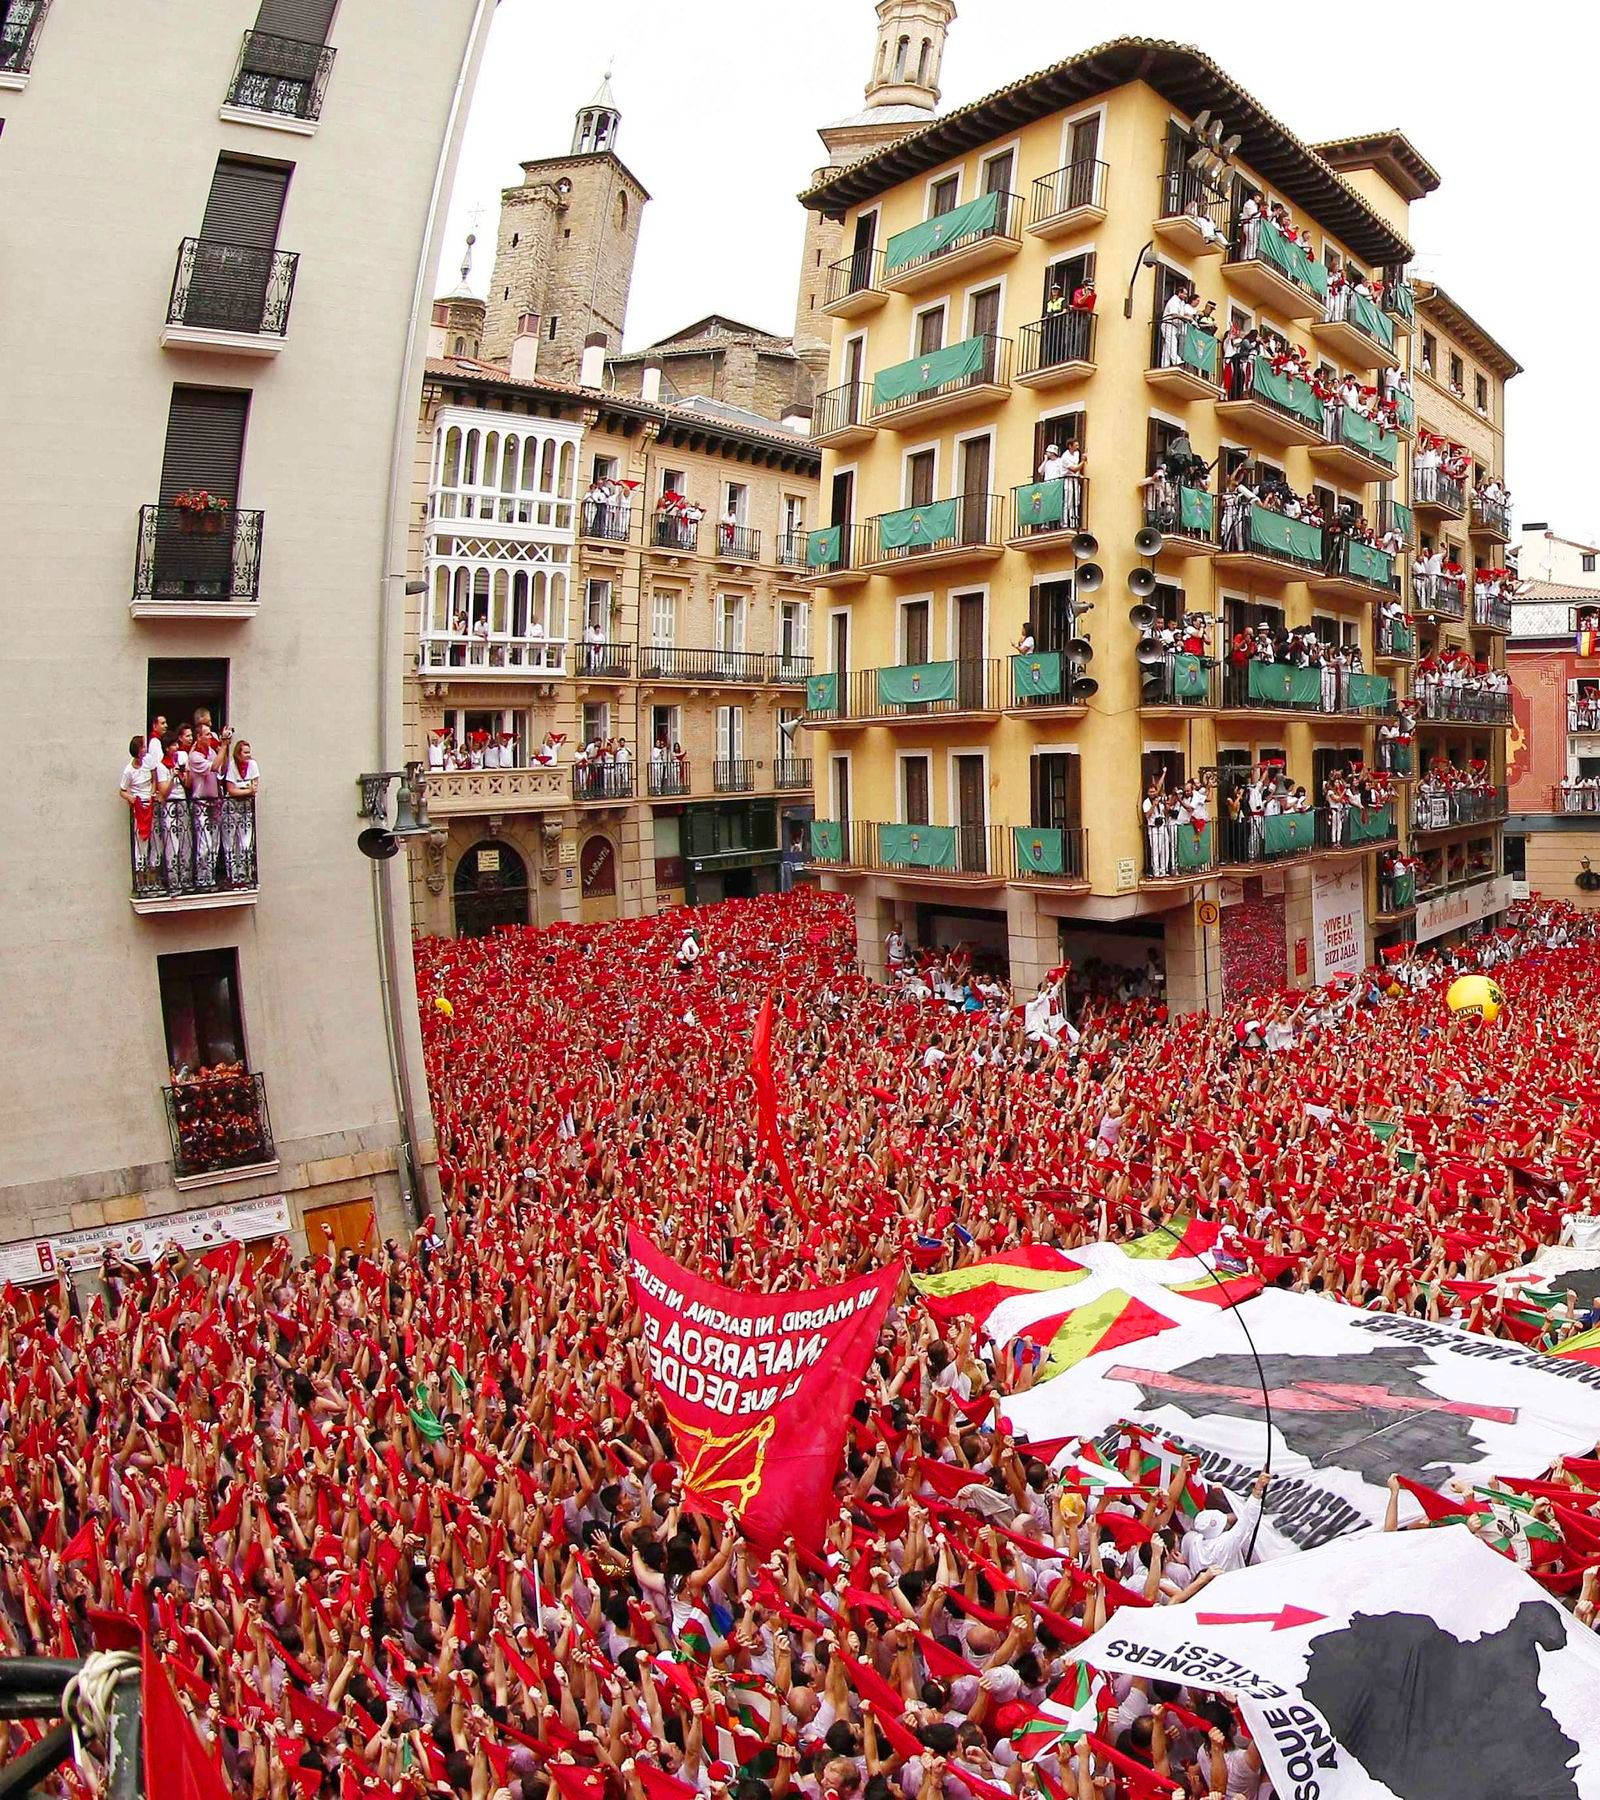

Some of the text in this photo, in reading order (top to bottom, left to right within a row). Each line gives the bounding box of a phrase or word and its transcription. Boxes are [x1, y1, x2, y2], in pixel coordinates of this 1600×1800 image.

[1343, 913, 1352, 926] LA
[1327, 928, 1353, 948] FIESTA!
[1325, 948, 1339, 966] BIZI
[1350, 1314, 1450, 1347] EXILES
[1449, 1336, 1524, 1361] AND
[1175, 1641, 1338, 1769] AND EXILES!
